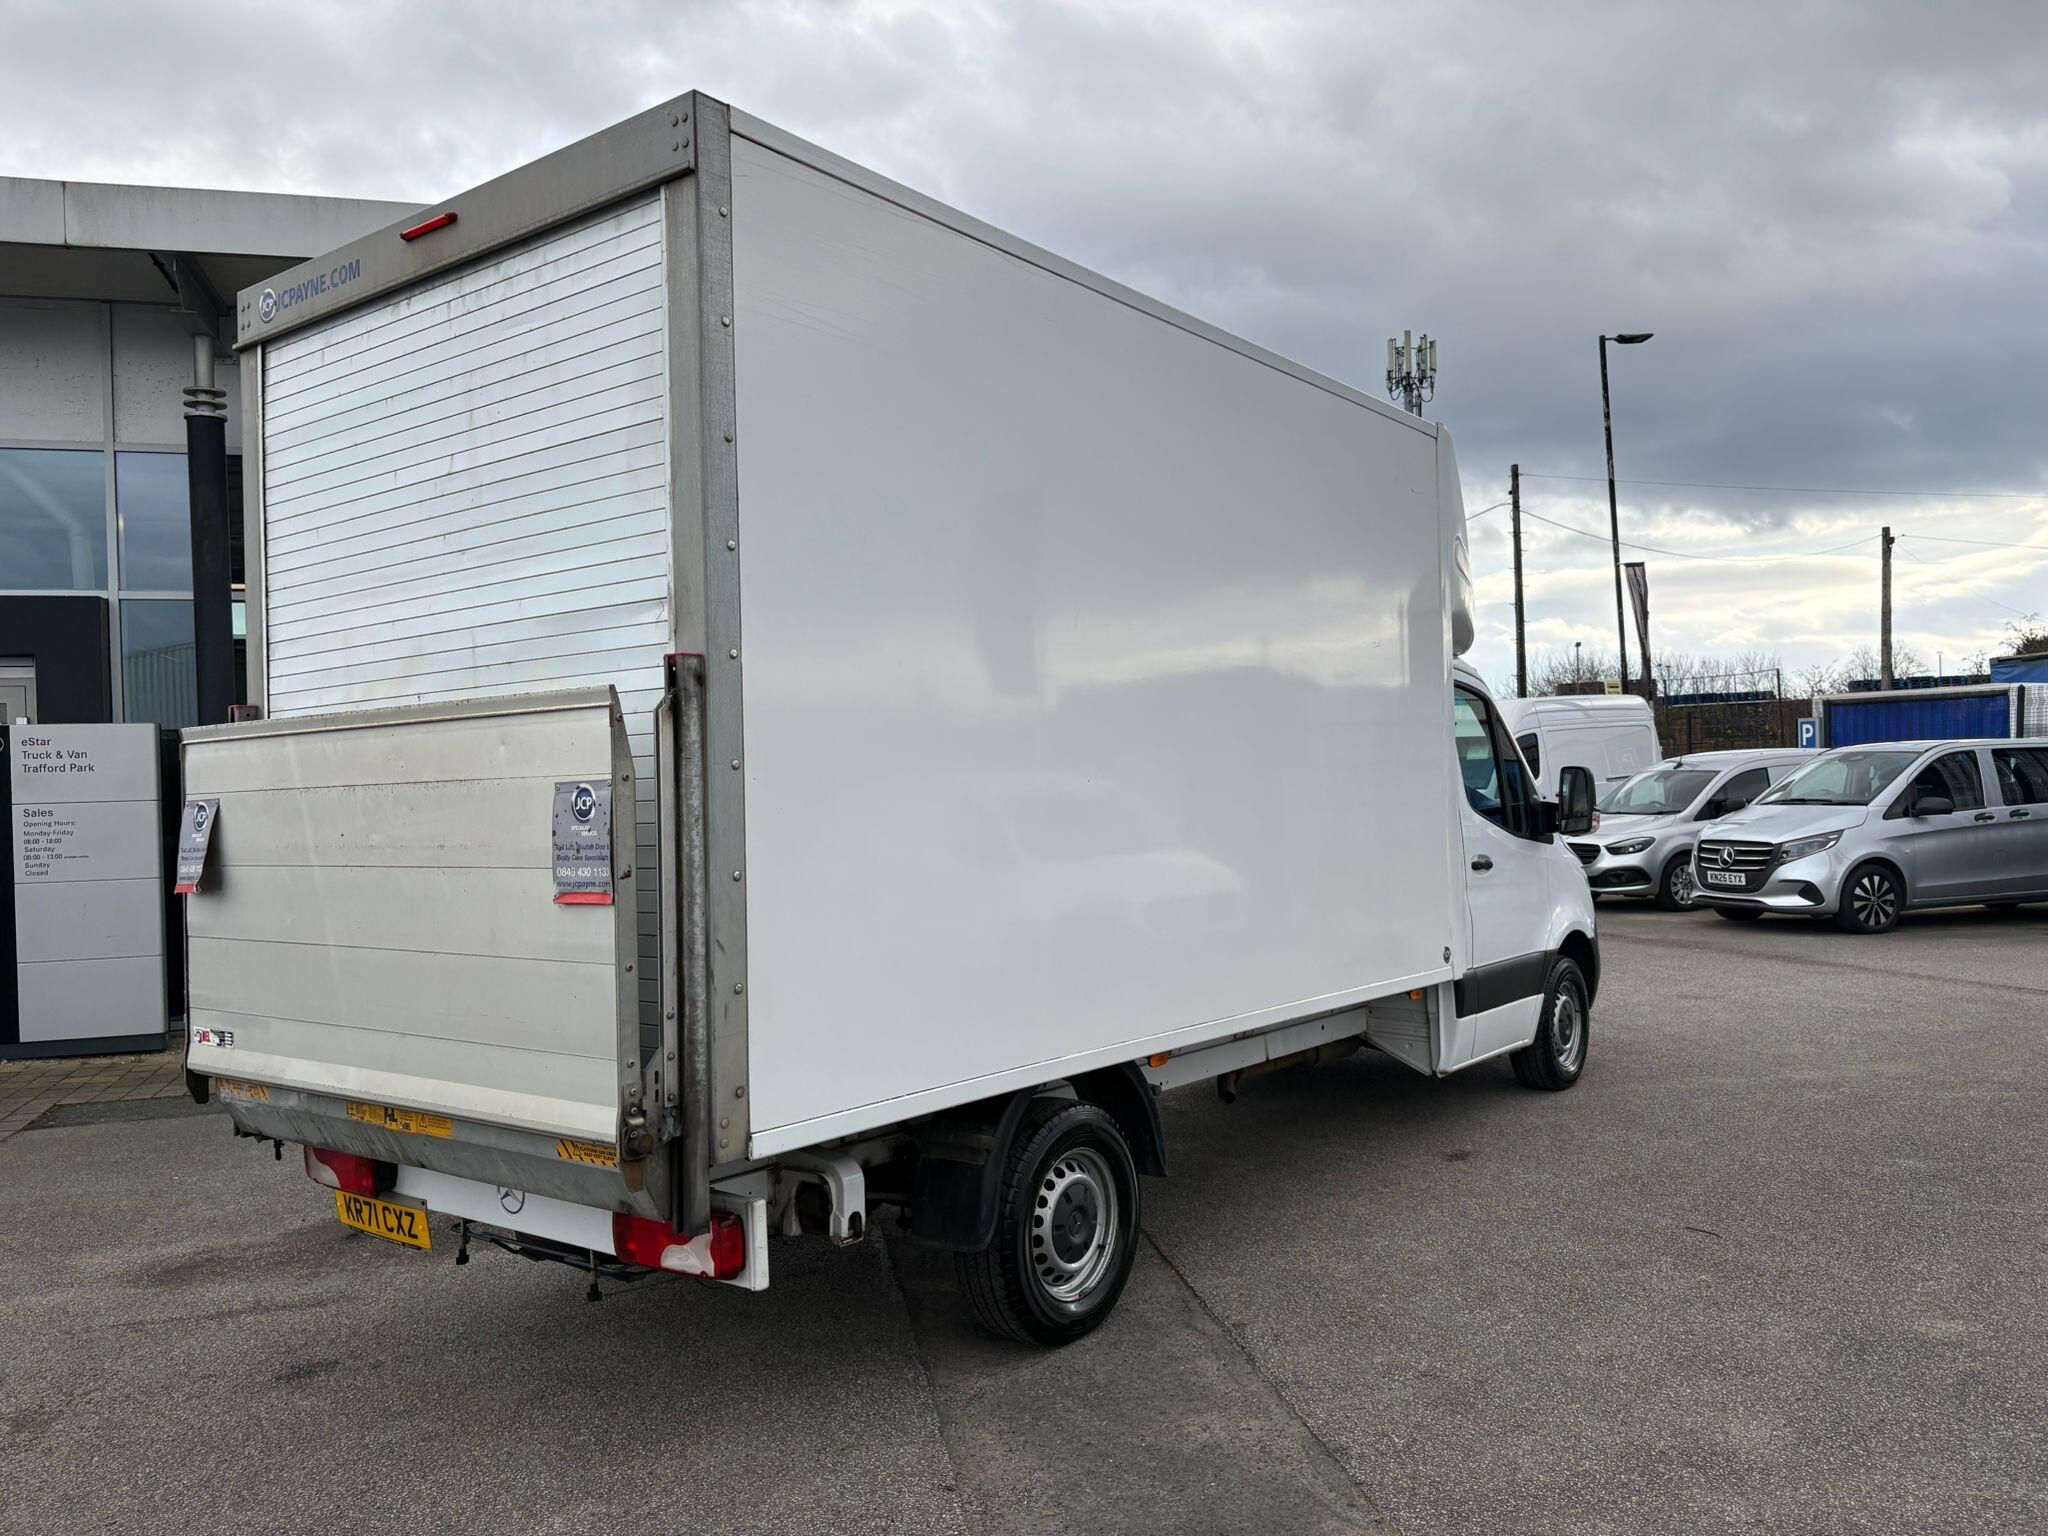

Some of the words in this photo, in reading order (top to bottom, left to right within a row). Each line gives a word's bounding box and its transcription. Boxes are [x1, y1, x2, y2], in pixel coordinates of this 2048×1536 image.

[1802, 723, 1814, 746] P
[21, 737, 52, 746] eStar
[21, 750, 53, 760] Truck
[55, 750, 64, 759] &
[66, 749, 88, 759] Van
[22, 763, 66, 773] Trafford
[69, 763, 96, 772] Park
[575, 796, 592, 810] JCP
[23, 808, 54, 818] Sales
[556, 866, 576, 877] 0845
[577, 866, 592, 877] 430
[1728, 874, 1743, 883] EYX
[343, 1193, 380, 1230] KR71
[382, 1205, 419, 1240] CXZ
